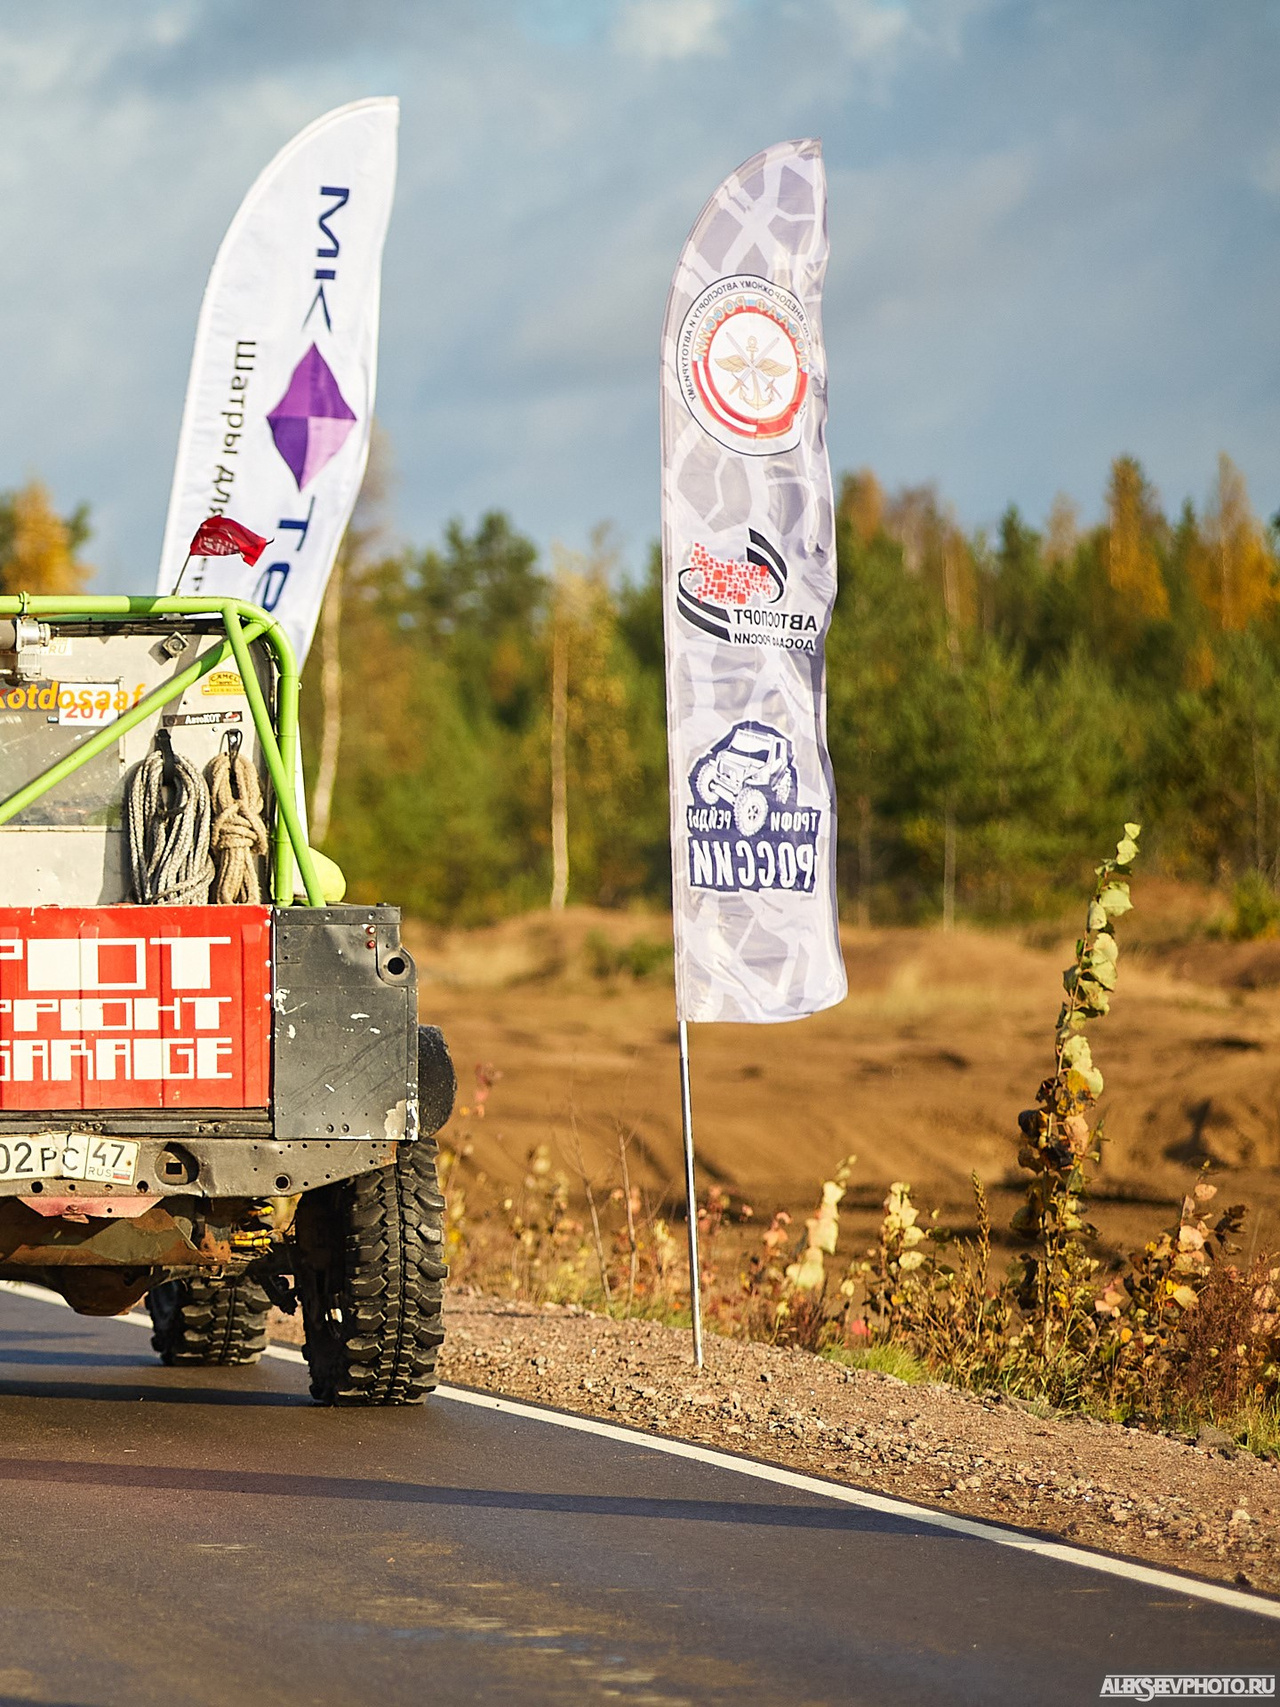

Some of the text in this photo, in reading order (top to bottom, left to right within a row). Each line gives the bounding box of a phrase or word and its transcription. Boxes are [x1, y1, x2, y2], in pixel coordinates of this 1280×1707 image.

[220, 341, 257, 454] Шатры
[210, 673, 238, 682] CAMEL
[92, 1142, 126, 1168] 47
[88, 1166, 112, 1177] RUS
